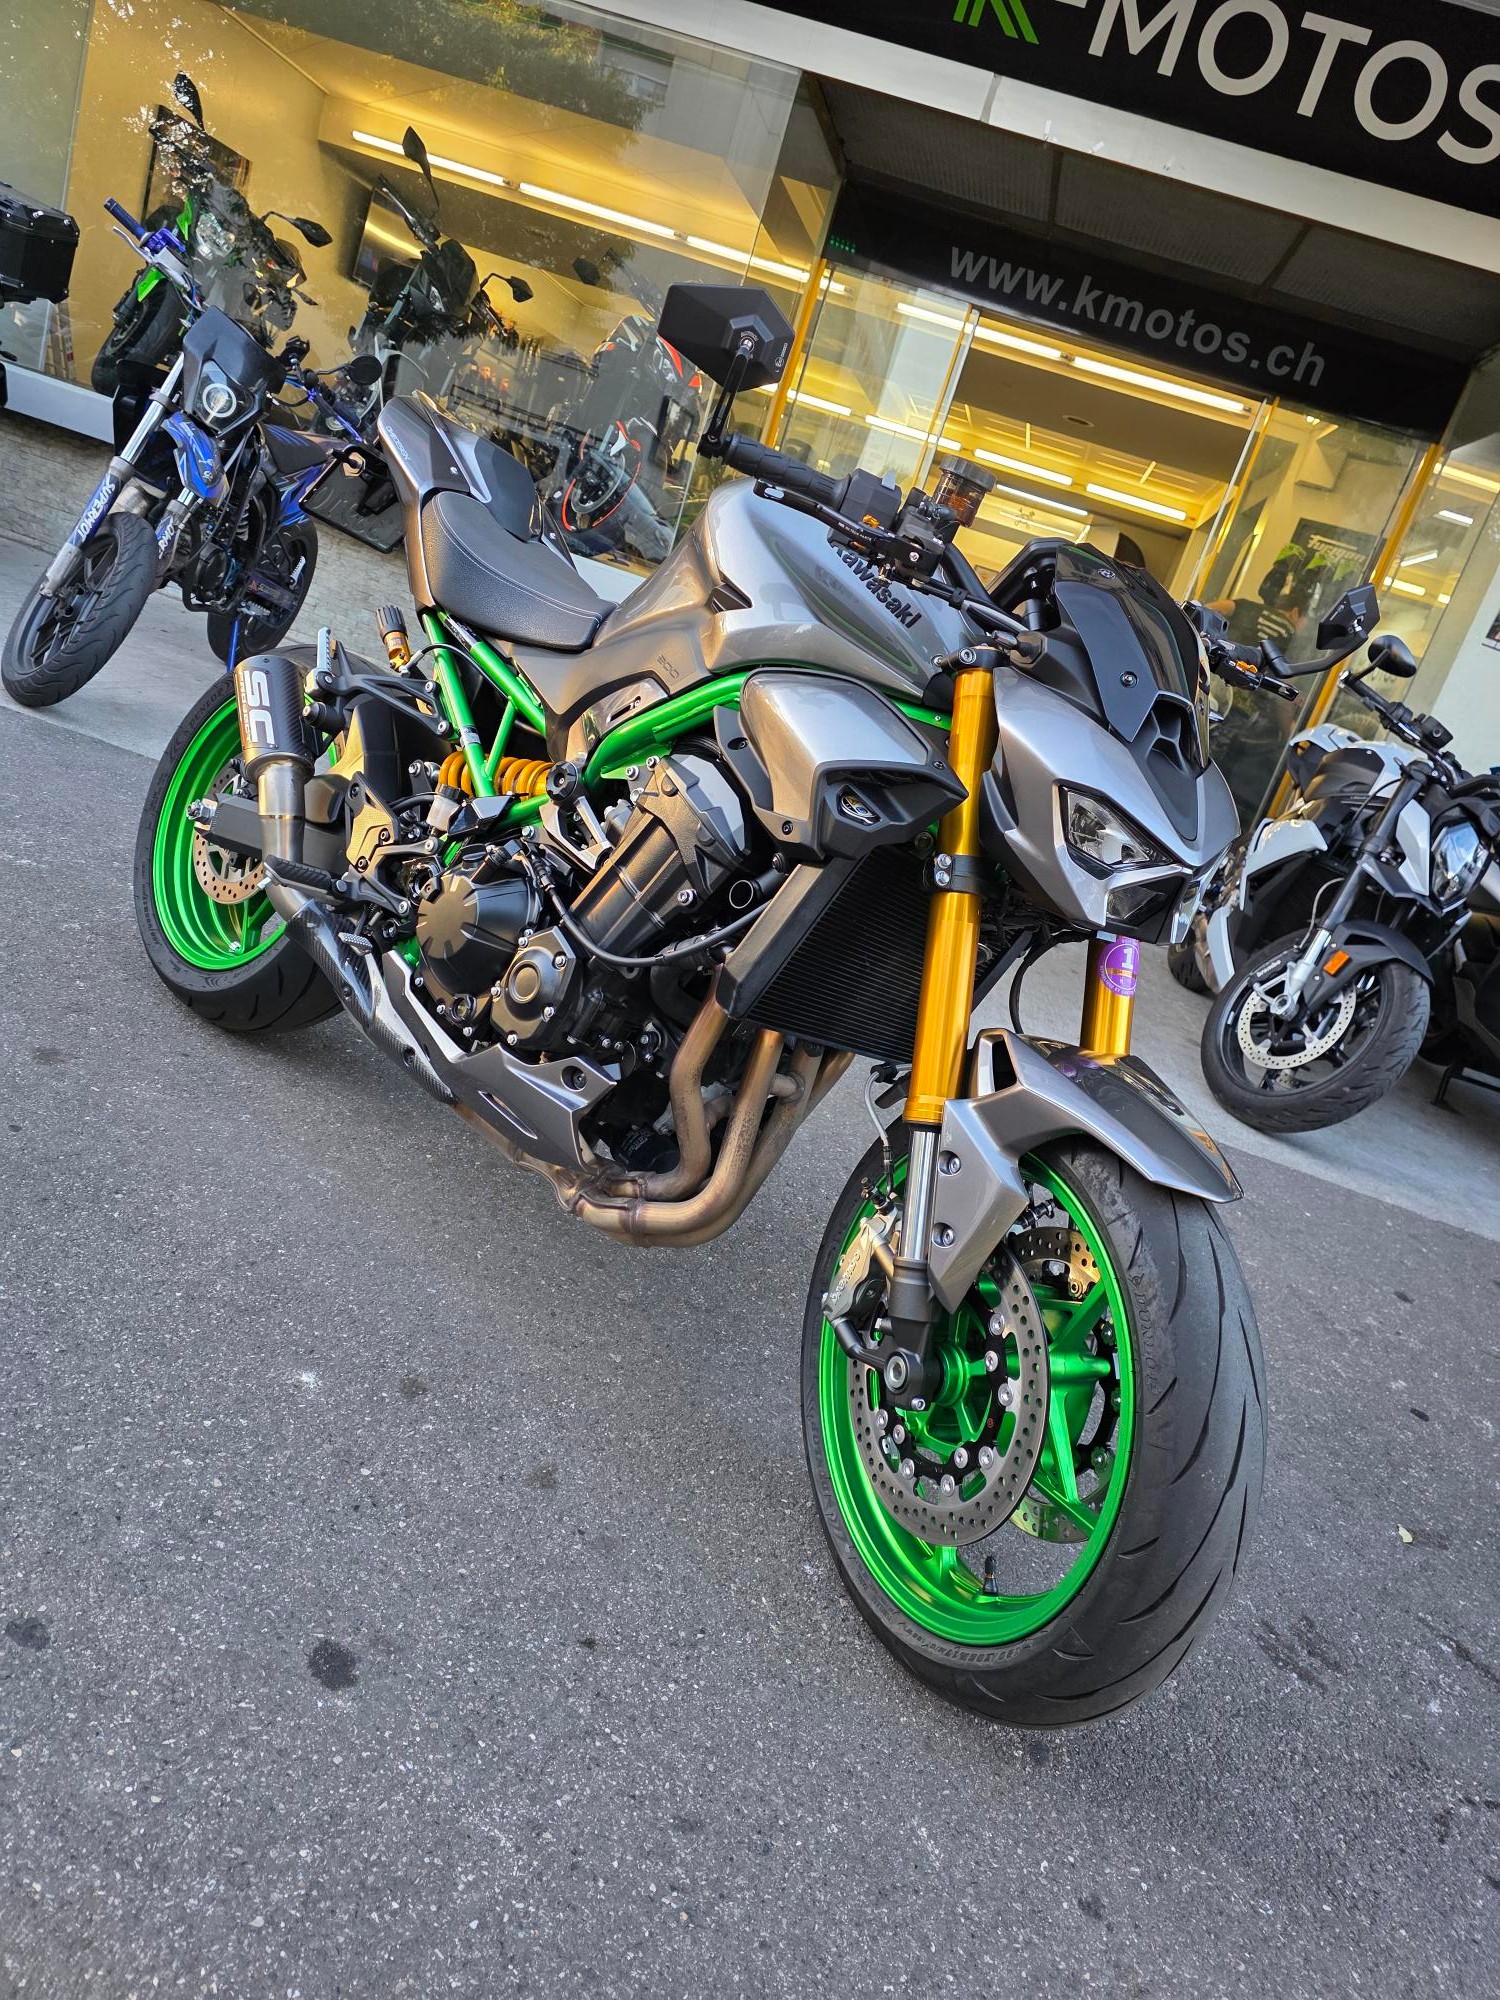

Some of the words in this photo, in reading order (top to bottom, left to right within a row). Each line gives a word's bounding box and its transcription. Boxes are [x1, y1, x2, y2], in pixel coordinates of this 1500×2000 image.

[950, 246, 1326, 388] www.kmotos.ch
[243, 670, 276, 745] SC
[1121, 947, 1134, 970] 1
[1133, 1291, 1160, 1394] DUNLOP
